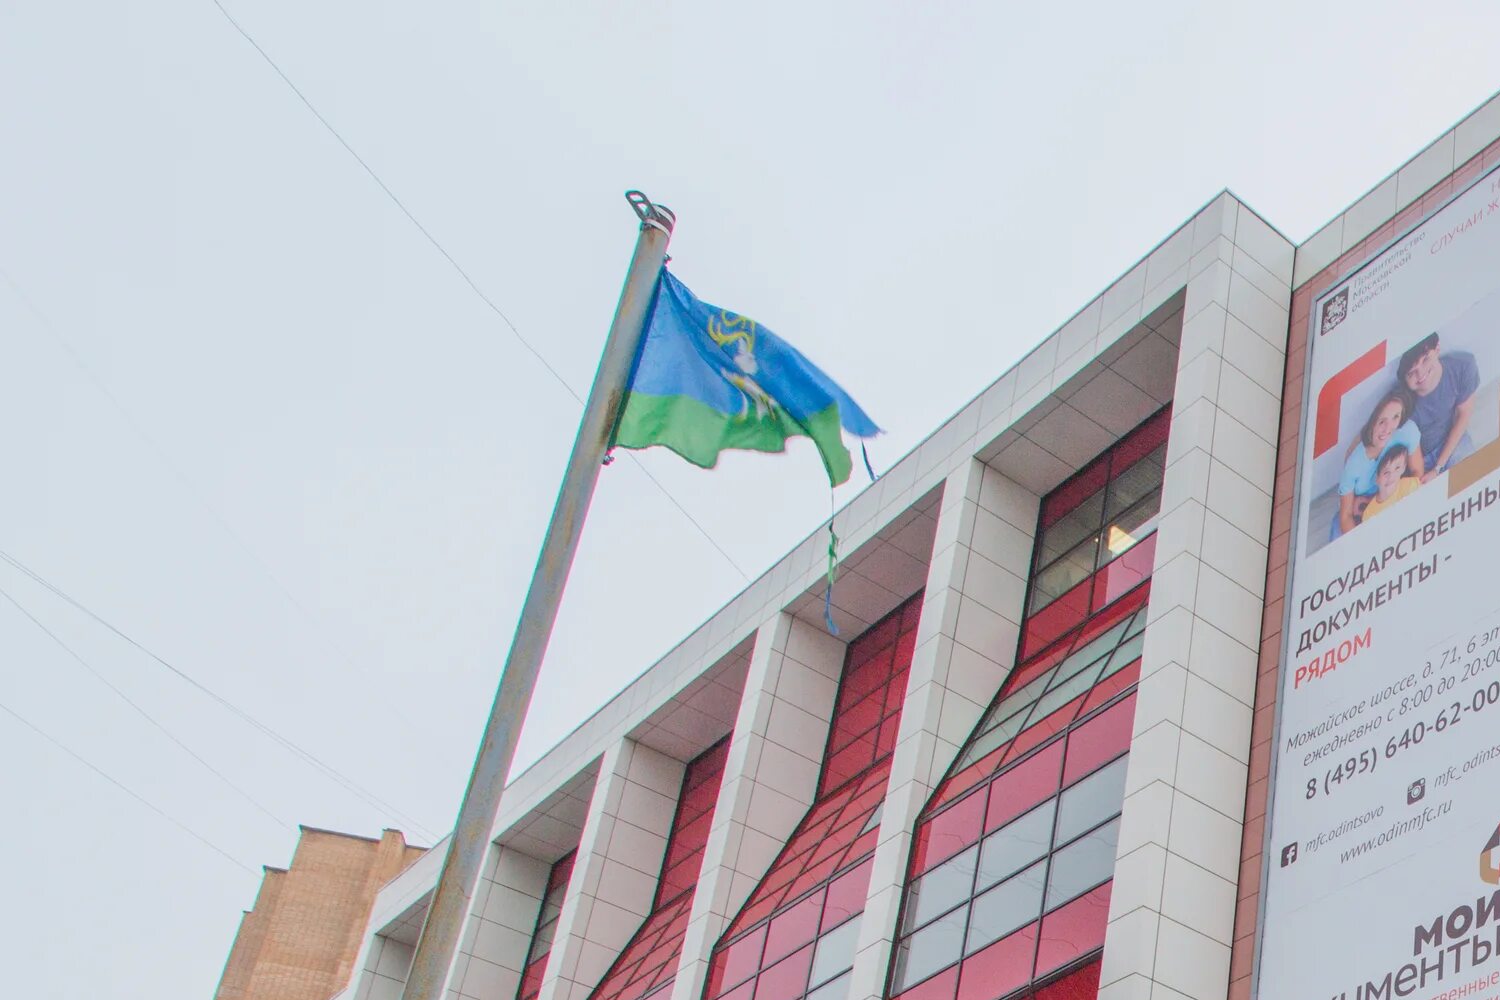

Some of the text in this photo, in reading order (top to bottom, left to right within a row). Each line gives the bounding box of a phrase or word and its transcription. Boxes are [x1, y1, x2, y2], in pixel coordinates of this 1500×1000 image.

[1295, 556, 1438, 659] ДОКУМЕНТЫ
[1286, 699, 1366, 754] Можайское
[1370, 674, 1417, 708] шоссе,
[1467, 635, 1476, 654] 6
[1294, 627, 1372, 690] РЯДОМ
[1303, 715, 1382, 767] ежедневно
[1387, 708, 1395, 722] с
[1400, 684, 1432, 716] 8:00
[1438, 676, 1456, 695] до
[1306, 680, 1500, 800] 8 (495) 640-62-00
[1305, 805, 1384, 853] mfc.odintsovo
[1339, 799, 1452, 864] www.odinmfc.ru
